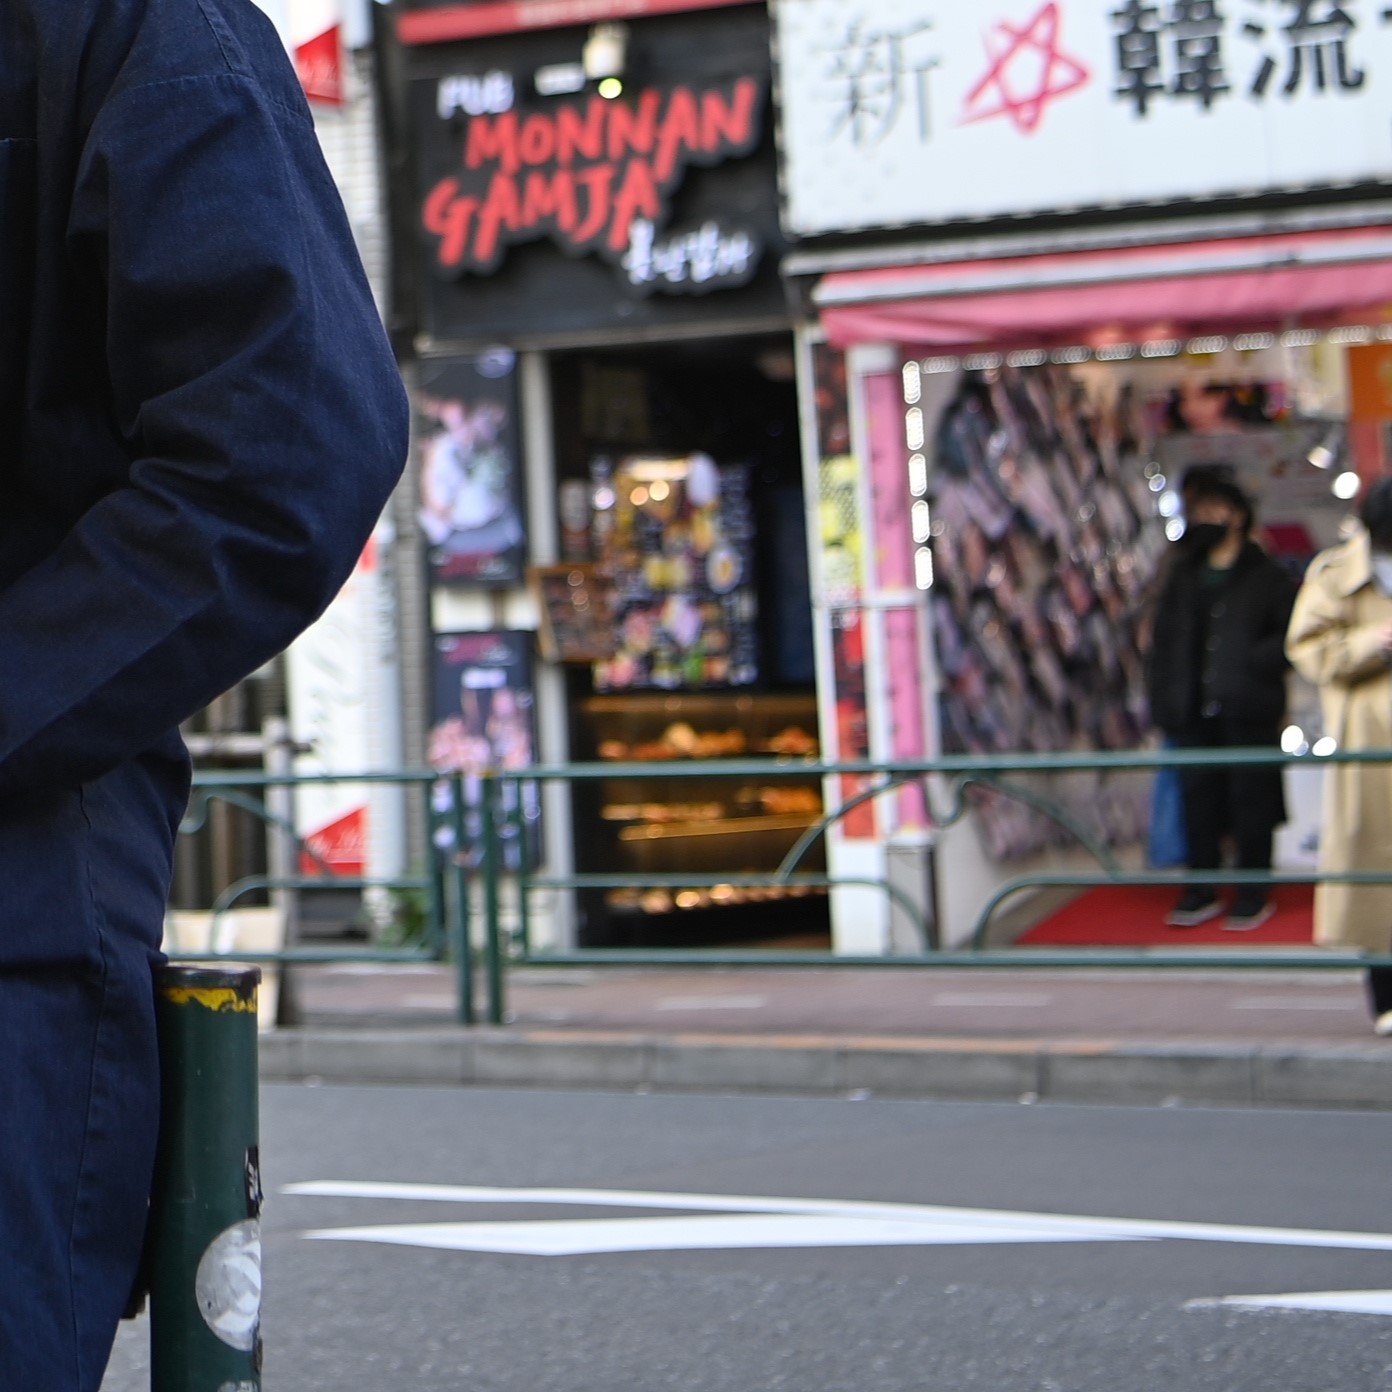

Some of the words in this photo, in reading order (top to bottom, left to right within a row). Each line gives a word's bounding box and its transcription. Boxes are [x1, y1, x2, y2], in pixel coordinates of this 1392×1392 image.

[436, 69, 515, 121] PUB
[464, 75, 756, 183] MONNAN
[420, 158, 659, 267] GAMJA
